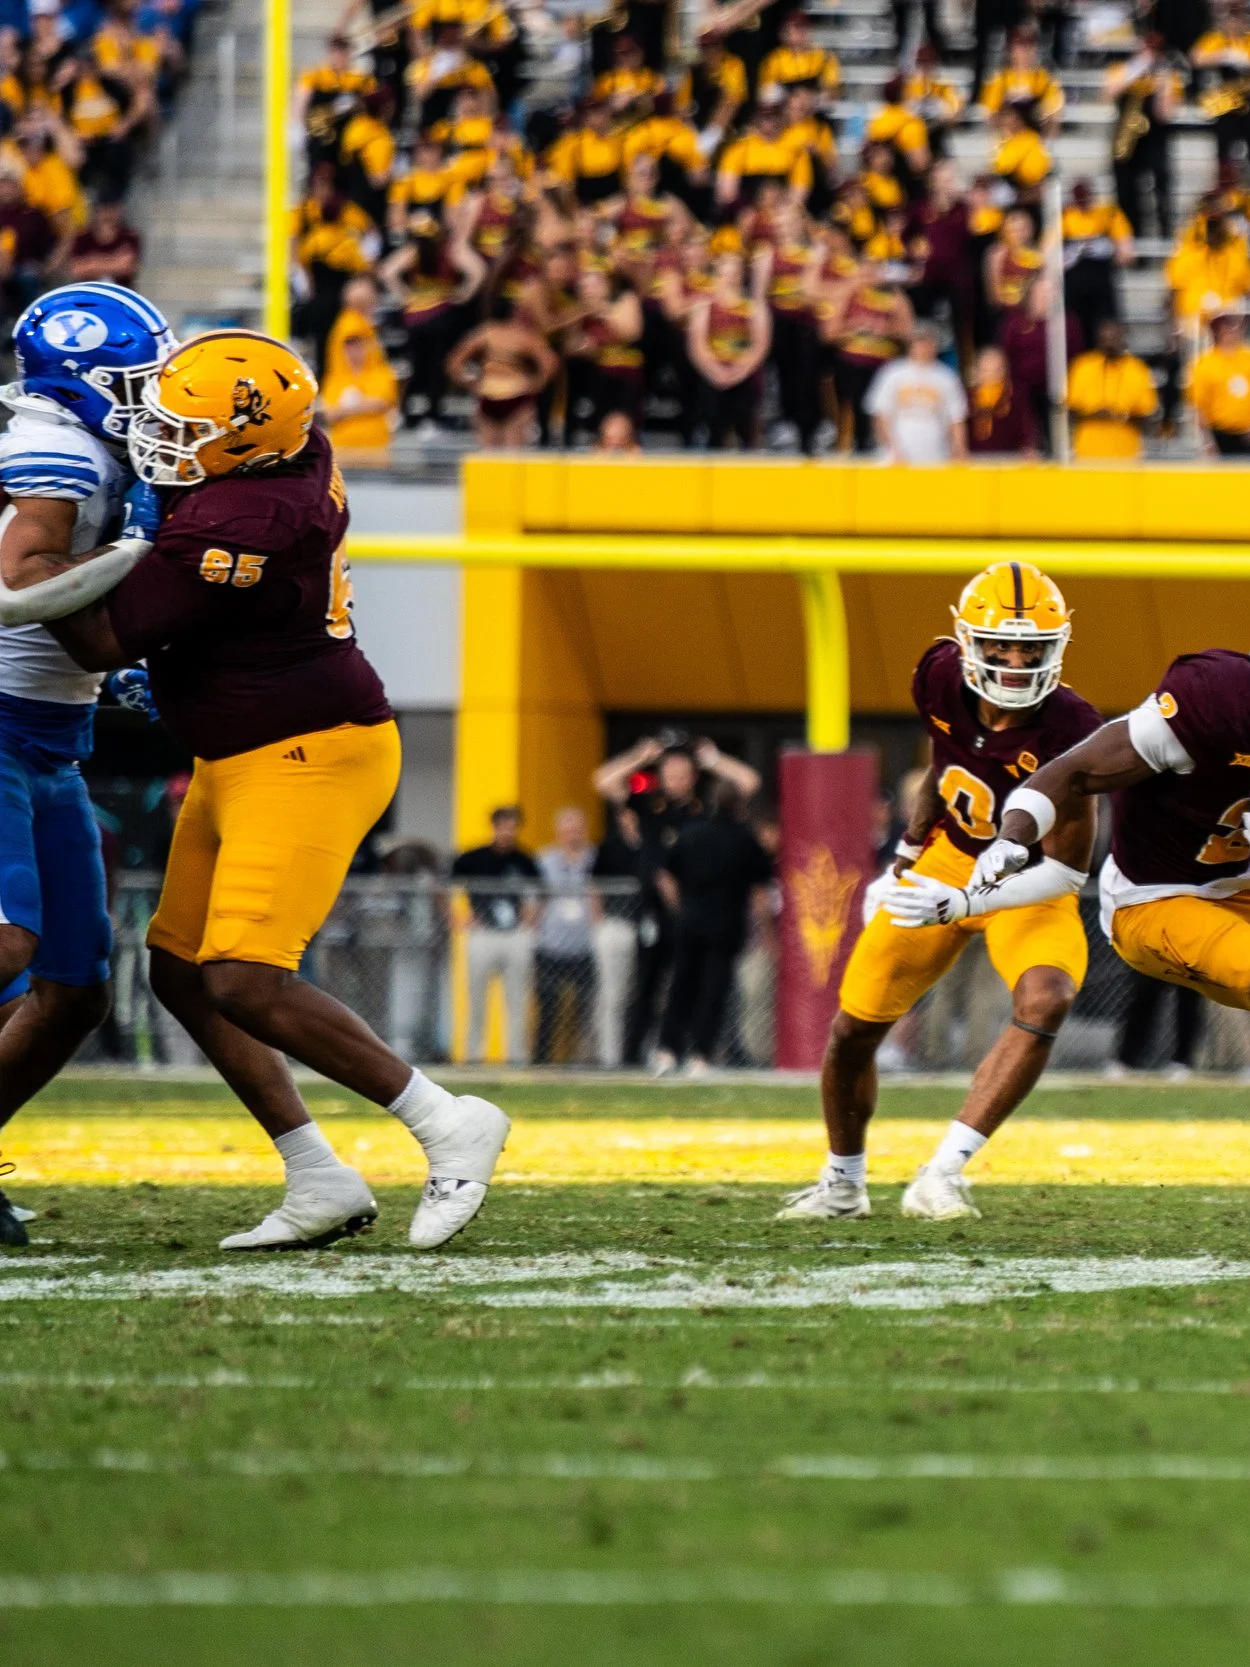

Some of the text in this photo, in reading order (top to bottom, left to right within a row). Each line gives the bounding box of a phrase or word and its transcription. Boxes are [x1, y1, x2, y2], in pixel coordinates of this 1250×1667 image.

[54, 313, 97, 348] Y
[200, 548, 269, 588] 65
[937, 764, 998, 841] 0
